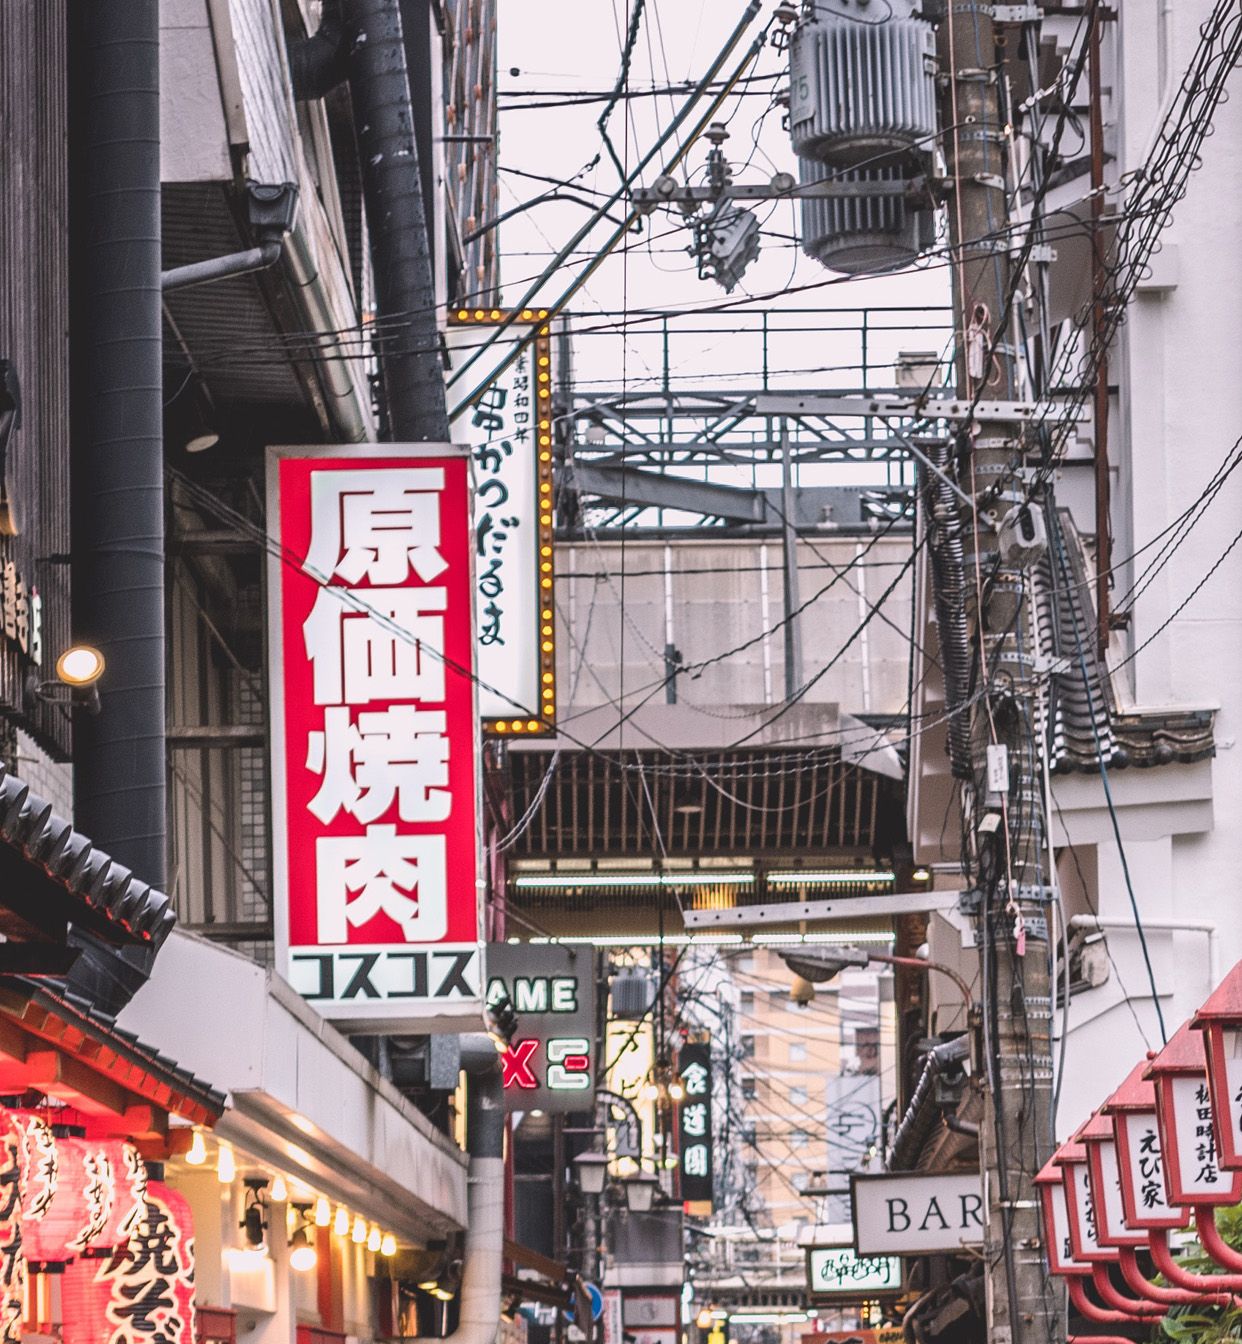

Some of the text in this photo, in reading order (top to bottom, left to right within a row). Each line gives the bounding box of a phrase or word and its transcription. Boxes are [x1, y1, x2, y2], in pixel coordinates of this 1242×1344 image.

[472, 381, 519, 647] 串かつだるま
[302, 467, 451, 943] 原価焼肉
[292, 951, 476, 999] コスコス
[1139, 1129, 1165, 1209] えび家
[884, 1194, 984, 1233] BAR
